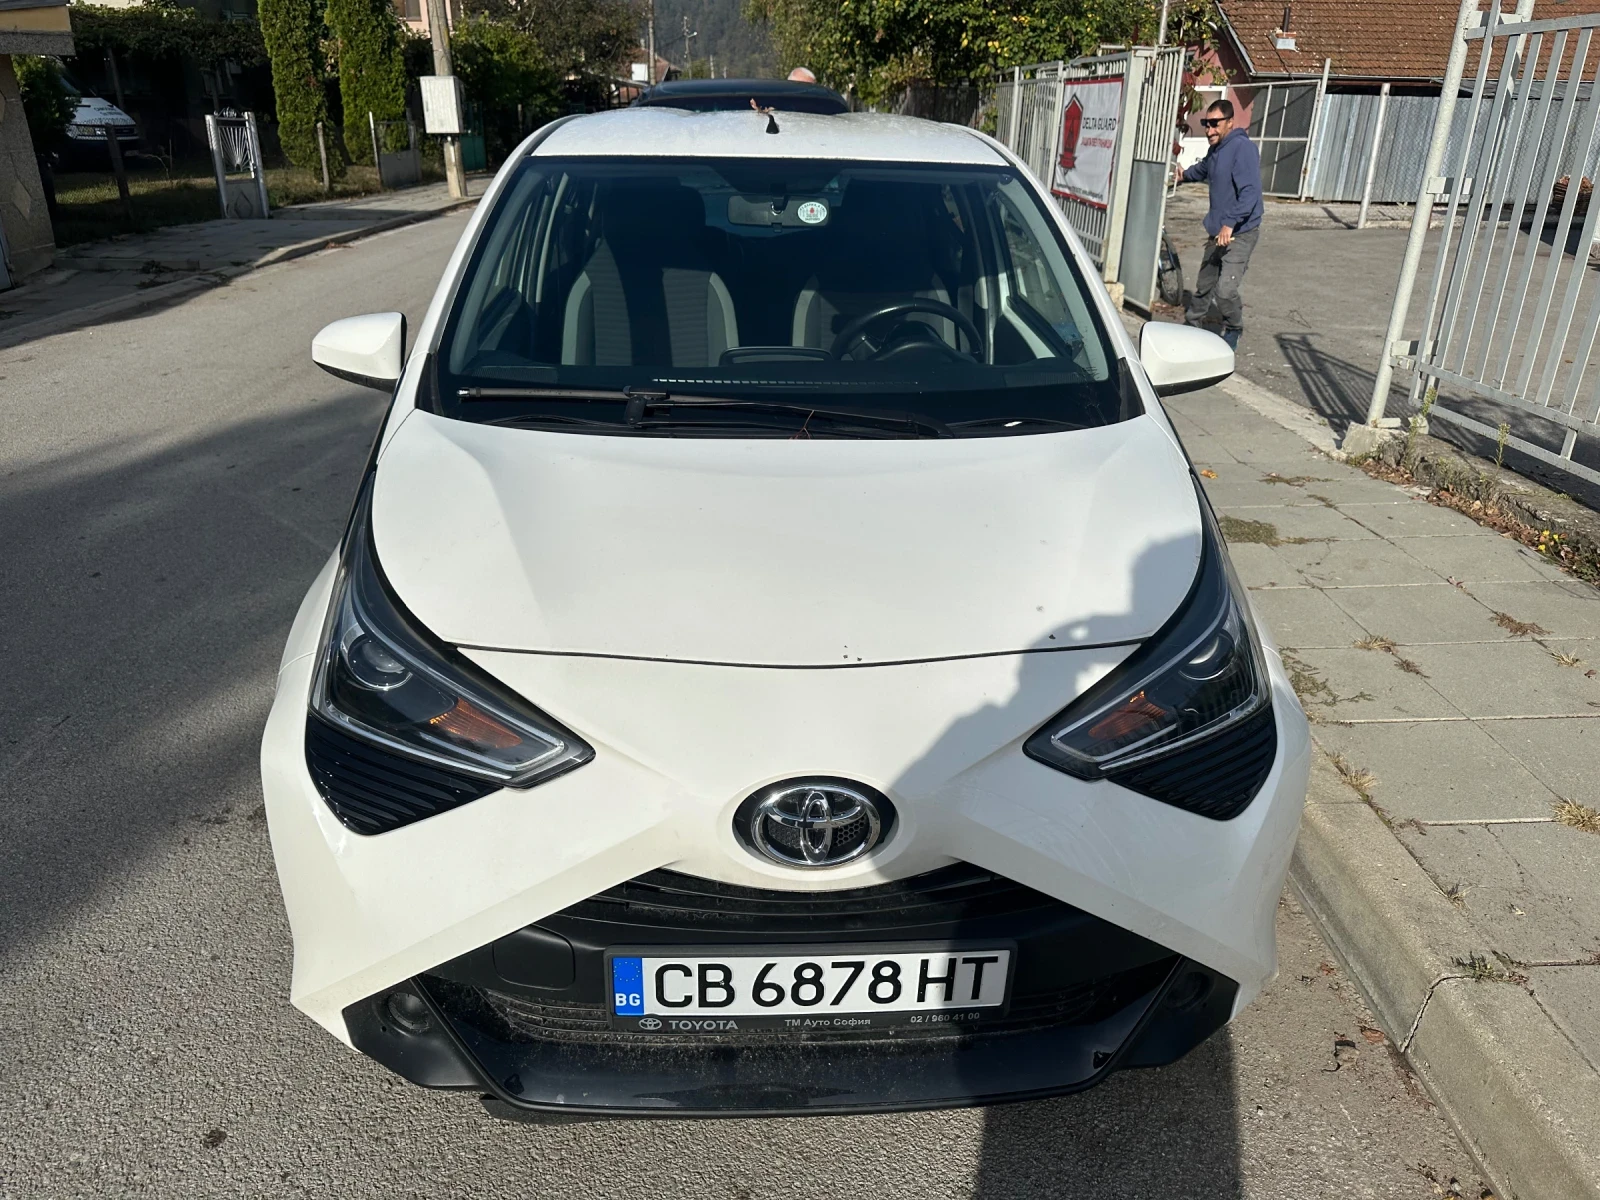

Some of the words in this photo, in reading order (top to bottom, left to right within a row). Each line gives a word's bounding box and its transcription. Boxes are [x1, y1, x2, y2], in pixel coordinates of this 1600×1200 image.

[1082, 117, 1097, 129] DELTA
[1098, 117, 1117, 130] GUARD
[655, 963, 735, 1008] CB
[752, 960, 902, 1007] 6878
[917, 956, 998, 1002] HT
[615, 993, 640, 1006] BG
[804, 1018, 830, 1028] Ауто
[833, 1018, 871, 1026] София
[910, 1015, 923, 1023] 02
[932, 1014, 950, 1022] 960
[952, 1013, 964, 1021] 41
[968, 1012, 980, 1020] 00
[669, 1020, 738, 1030] TOYOTA
